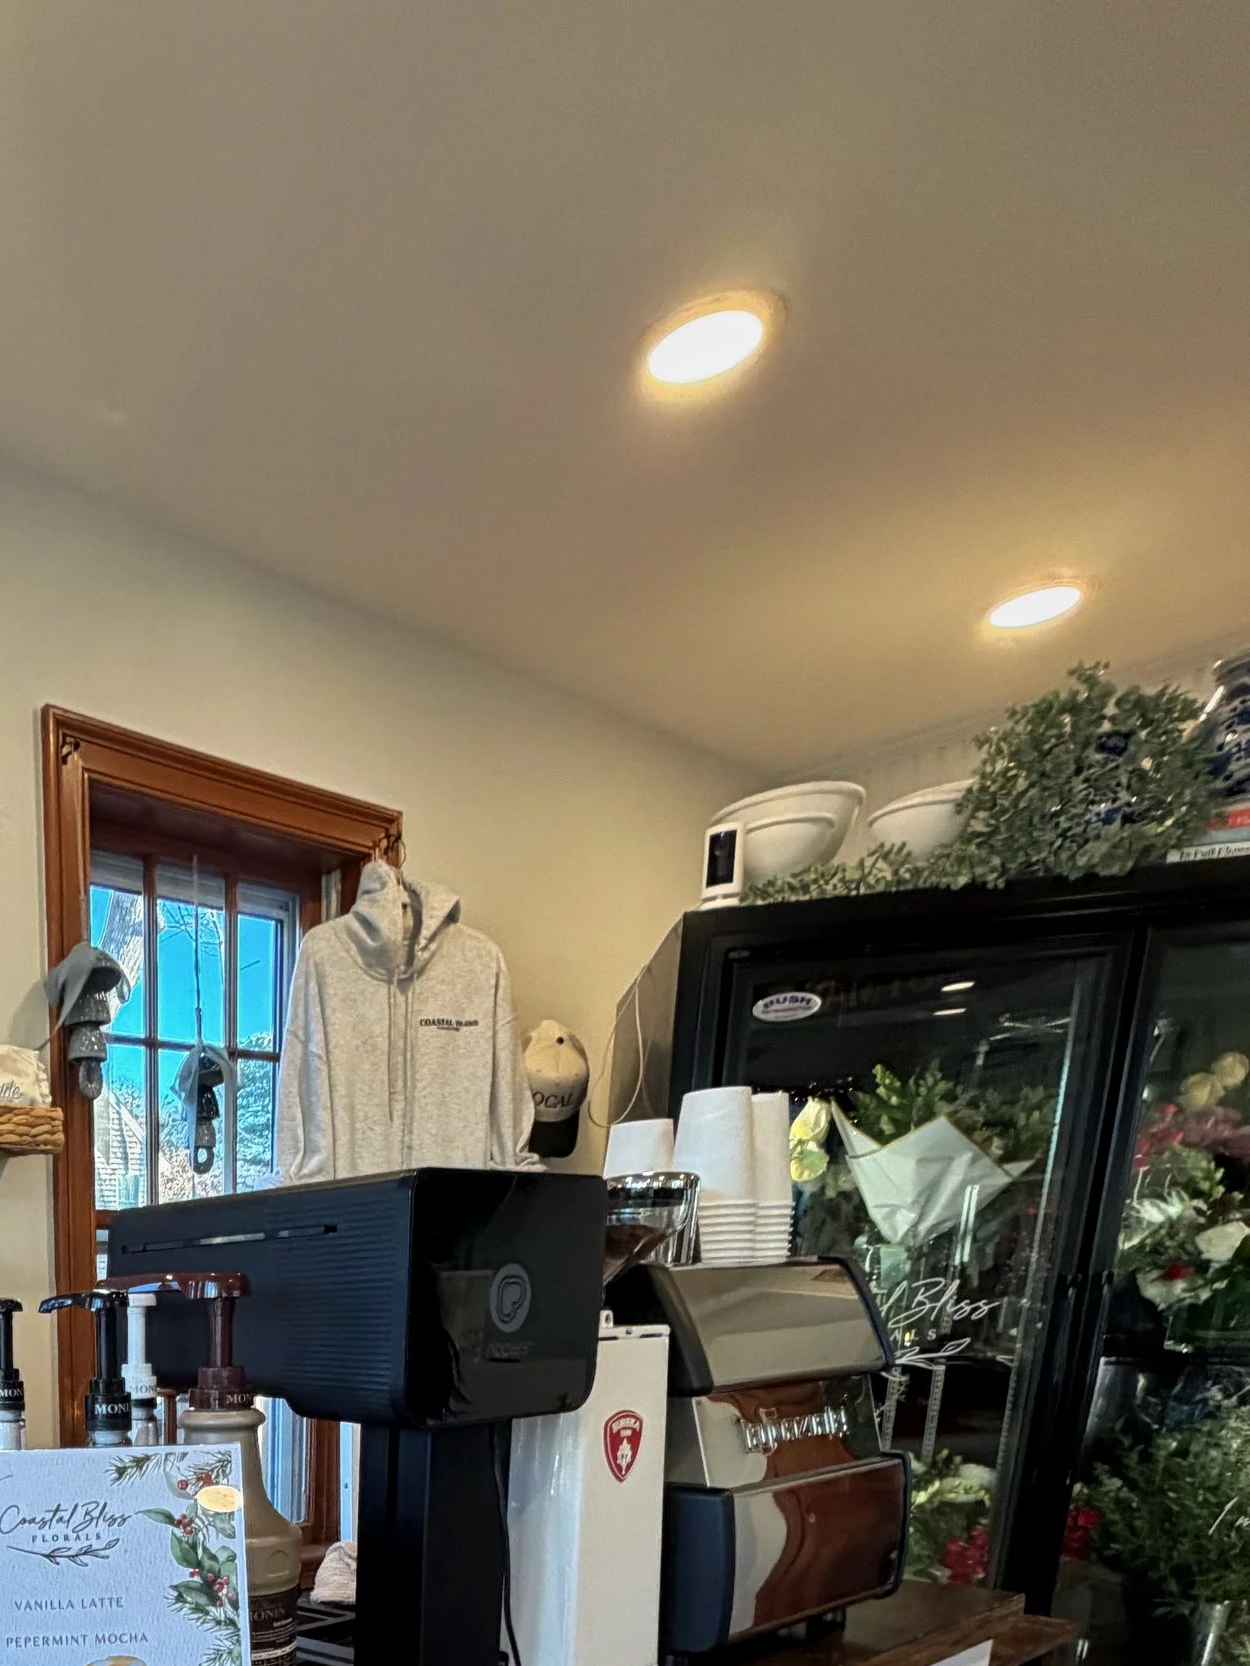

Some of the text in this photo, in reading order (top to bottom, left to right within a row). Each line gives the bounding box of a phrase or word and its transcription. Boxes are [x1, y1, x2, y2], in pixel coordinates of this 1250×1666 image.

[0, 1500, 133, 1535] Coastal Bliss
[31, 1533, 102, 1544] FLORALS
[14, 1596, 124, 1612] VANILLA LATTE
[6, 1632, 149, 1648] PEPERMINT MOCHA
